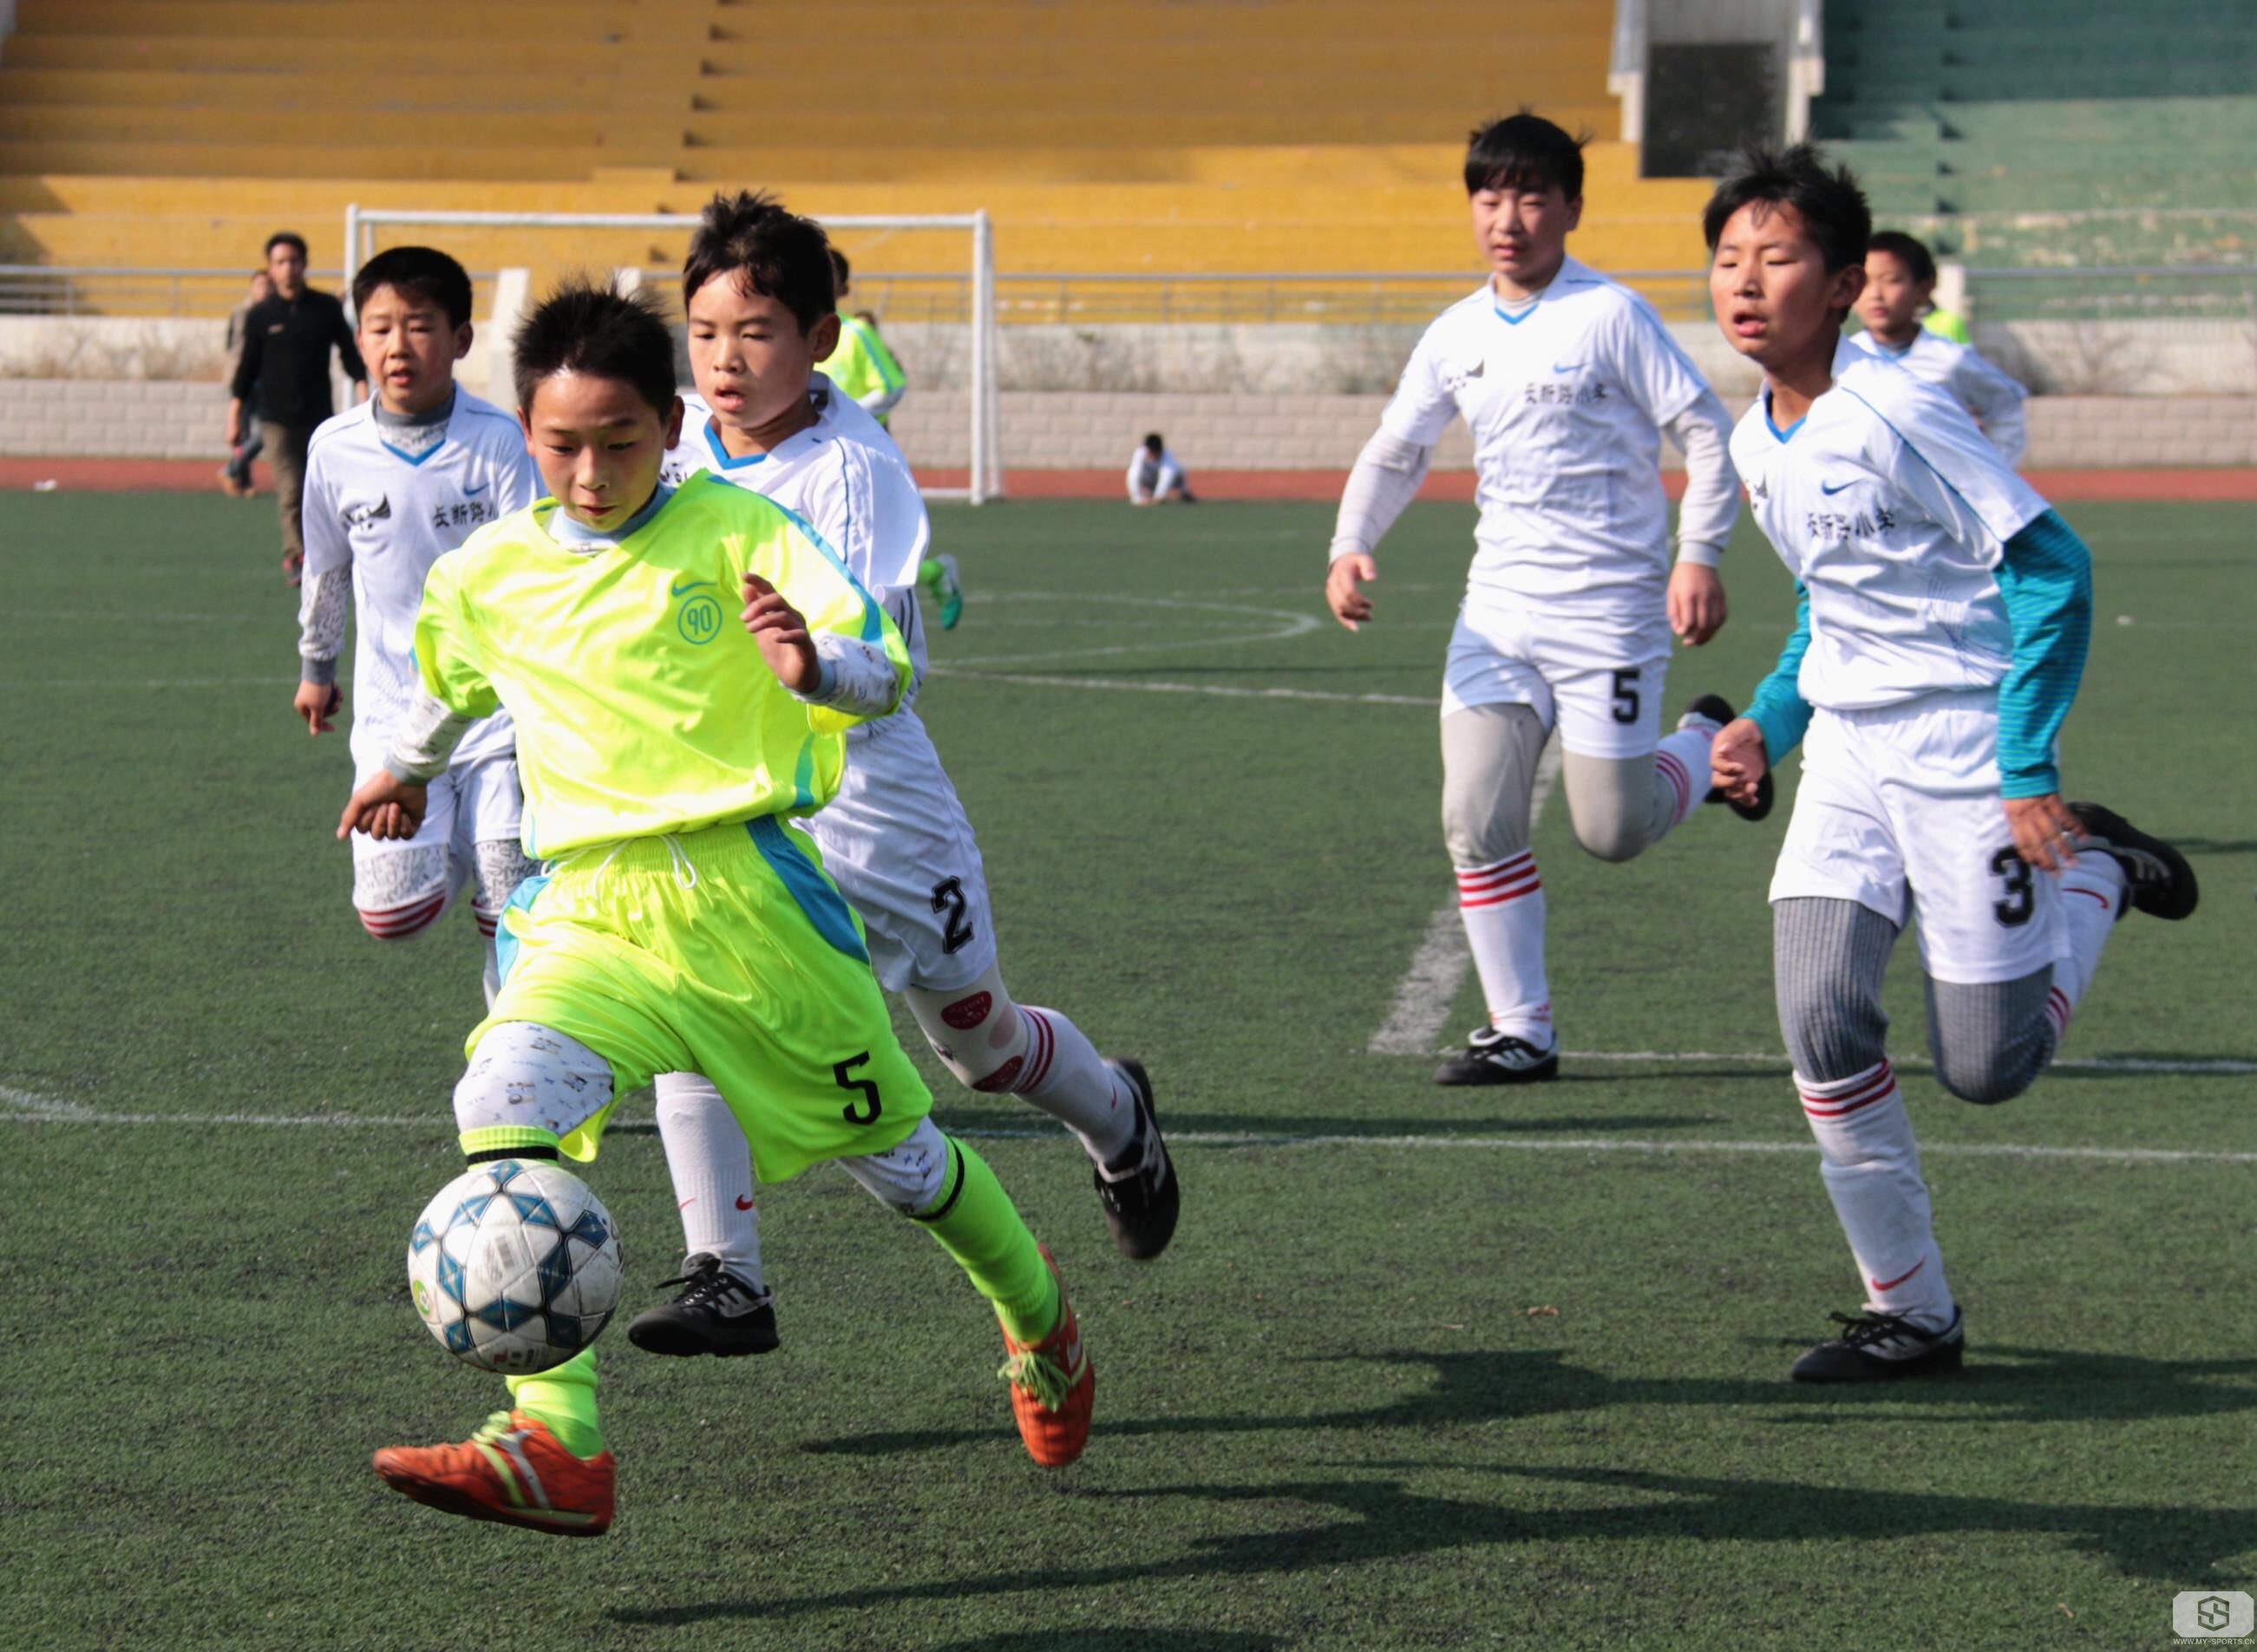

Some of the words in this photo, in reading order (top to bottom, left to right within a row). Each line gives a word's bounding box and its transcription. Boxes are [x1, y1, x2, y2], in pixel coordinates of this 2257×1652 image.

[687, 604, 712, 637] 90
[1612, 668, 1639, 725] 5
[931, 875, 975, 954] 2
[1990, 845, 2034, 928] 3
[833, 1050, 882, 1125] 5
